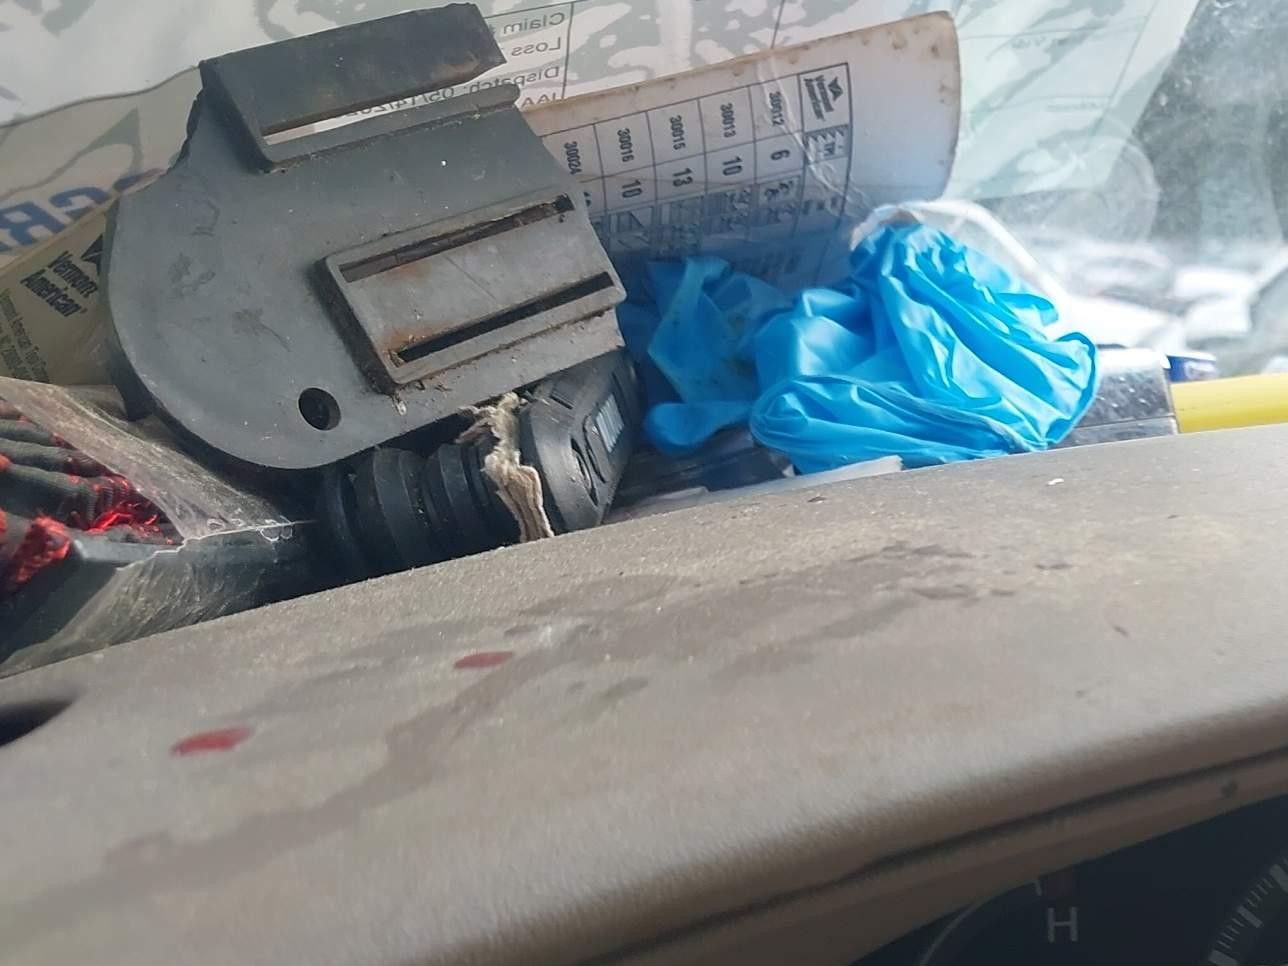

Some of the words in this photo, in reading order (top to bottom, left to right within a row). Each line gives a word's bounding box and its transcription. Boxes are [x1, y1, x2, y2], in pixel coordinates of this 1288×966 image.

[669, 115, 687, 151] 30015
[719, 102, 736, 139] 30013
[564, 141, 583, 175] 30024
[722, 156, 743, 177] 10
[770, 149, 790, 161] 6
[620, 179, 643, 199] 10
[671, 167, 693, 188] 13
[1047, 906, 1079, 942] H
